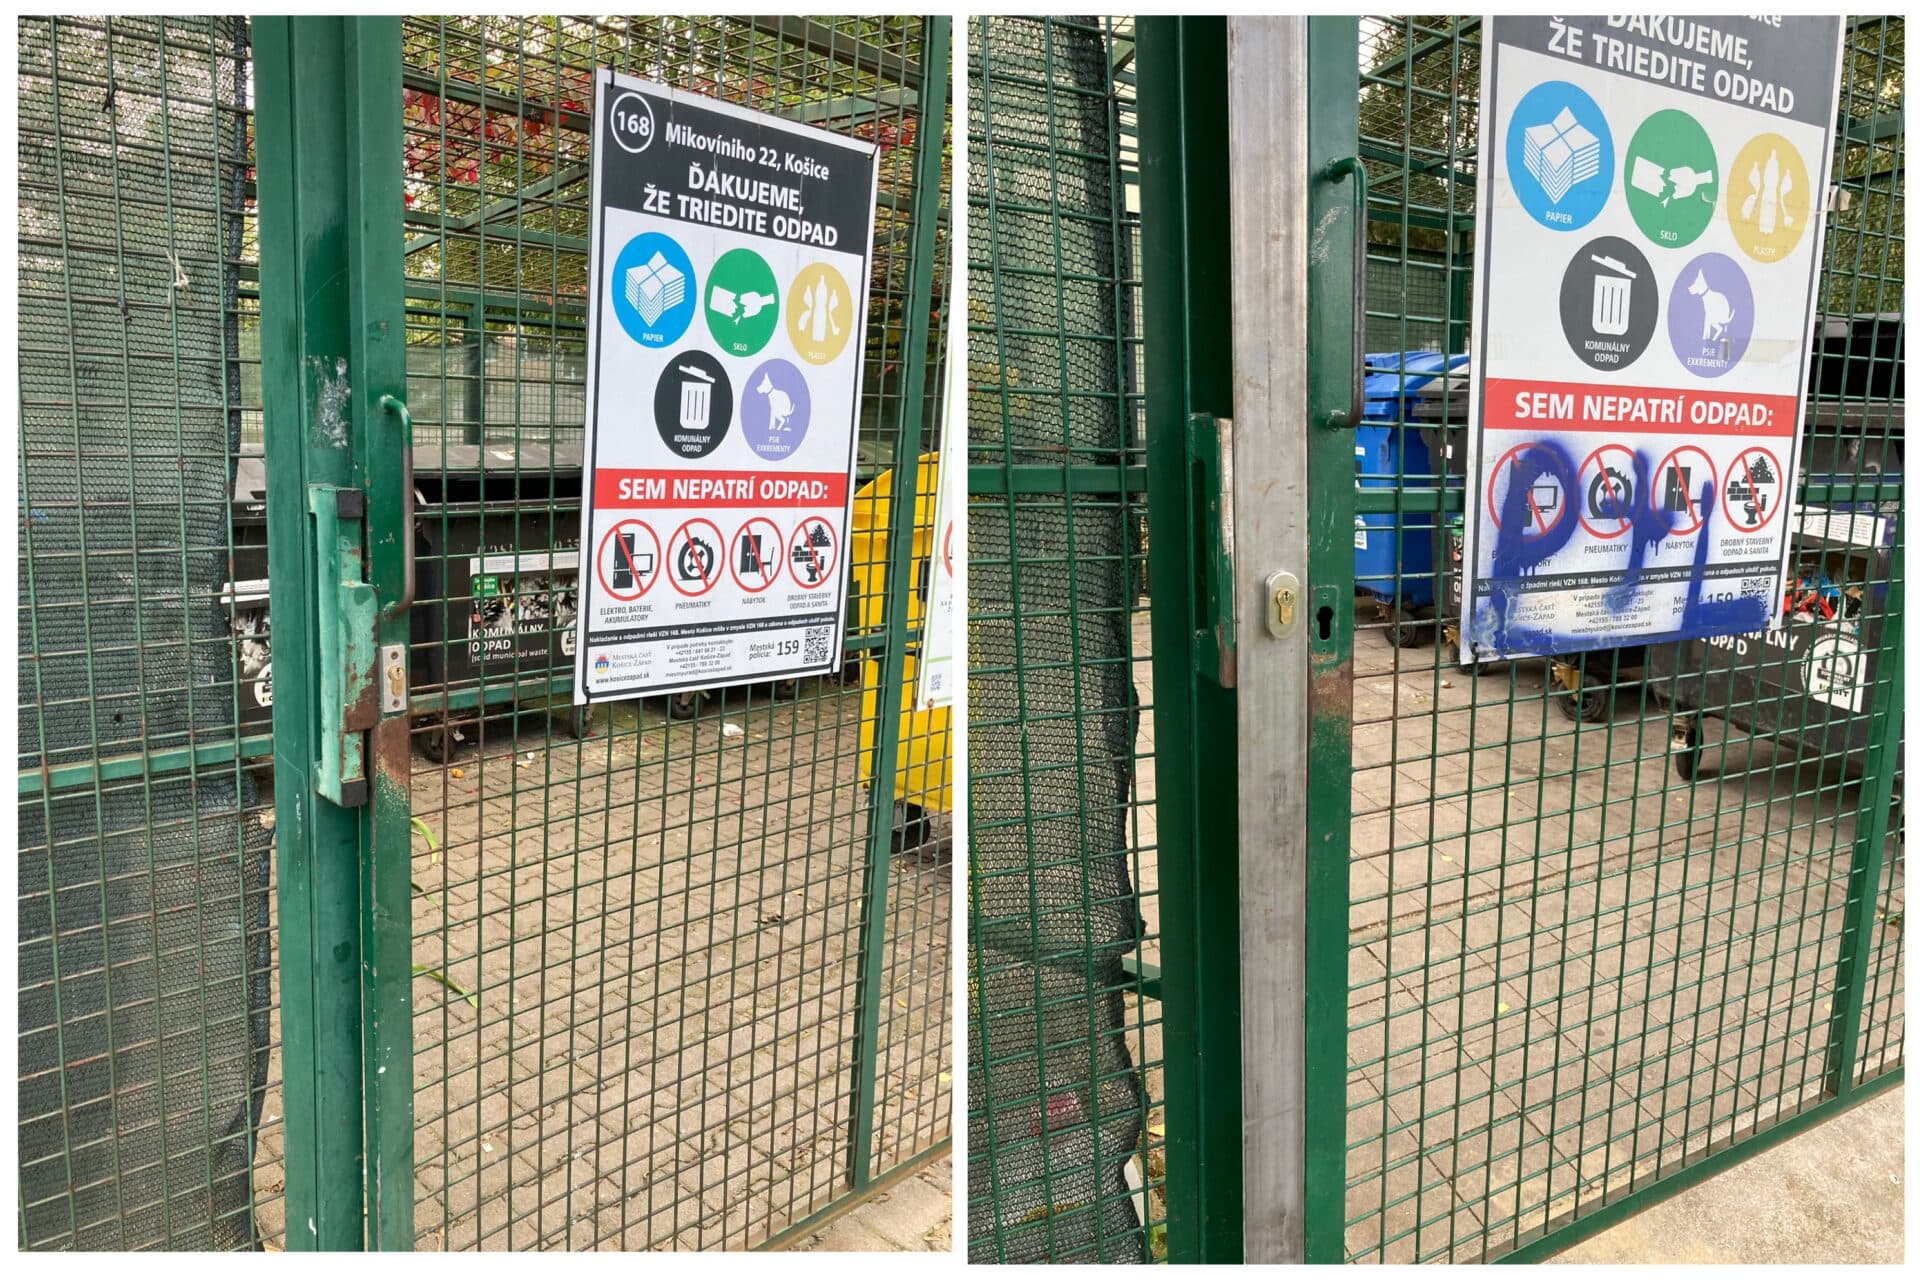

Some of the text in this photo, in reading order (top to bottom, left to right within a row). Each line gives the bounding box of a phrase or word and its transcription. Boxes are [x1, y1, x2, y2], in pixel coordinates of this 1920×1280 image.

[1547, 16, 1794, 114] ŽE TRIEDITE ODPAD
[616, 111, 650, 137] 168
[665, 122, 830, 181] Mikovíniho 22, Košice
[688, 162, 804, 216] ĎAKUJEME,
[643, 183, 838, 247] ŽE TRIEDITE ODPAD
[1546, 210, 1572, 225] PAPIER
[1660, 230, 1677, 241] SKLO
[1753, 246, 1776, 257] PLASTY
[642, 332, 664, 343] PAPIER
[733, 343, 748, 352] SKLO
[1584, 339, 1631, 354] KOMUNÁLNY
[1702, 347, 1716, 357] PSIE
[1594, 352, 1619, 364] ODPAD
[1687, 357, 1728, 369] EXKREMENTY
[1515, 391, 1773, 427] SEM NEPATRÍ ODPAD:
[674, 434, 711, 445] KOMUNÁLNY
[769, 436, 780, 444] PSIE
[682, 444, 702, 453] ODPAD
[618, 476, 828, 500] SEM NEPATRÍ ODPAD:
[1665, 540, 1694, 550] NÁBYTOK
[1720, 536, 1774, 547] DROBNÝ STAVEBNÝ
[1584, 544, 1628, 554] PNEUMATIKY
[1723, 548, 1742, 556] ODPAD
[1749, 547, 1769, 555] SANITA
[675, 601, 711, 610] PNEUMATIKY
[776, 639, 799, 656] 159
[471, 652, 490, 663] (soid
[492, 650, 528, 660] munical
